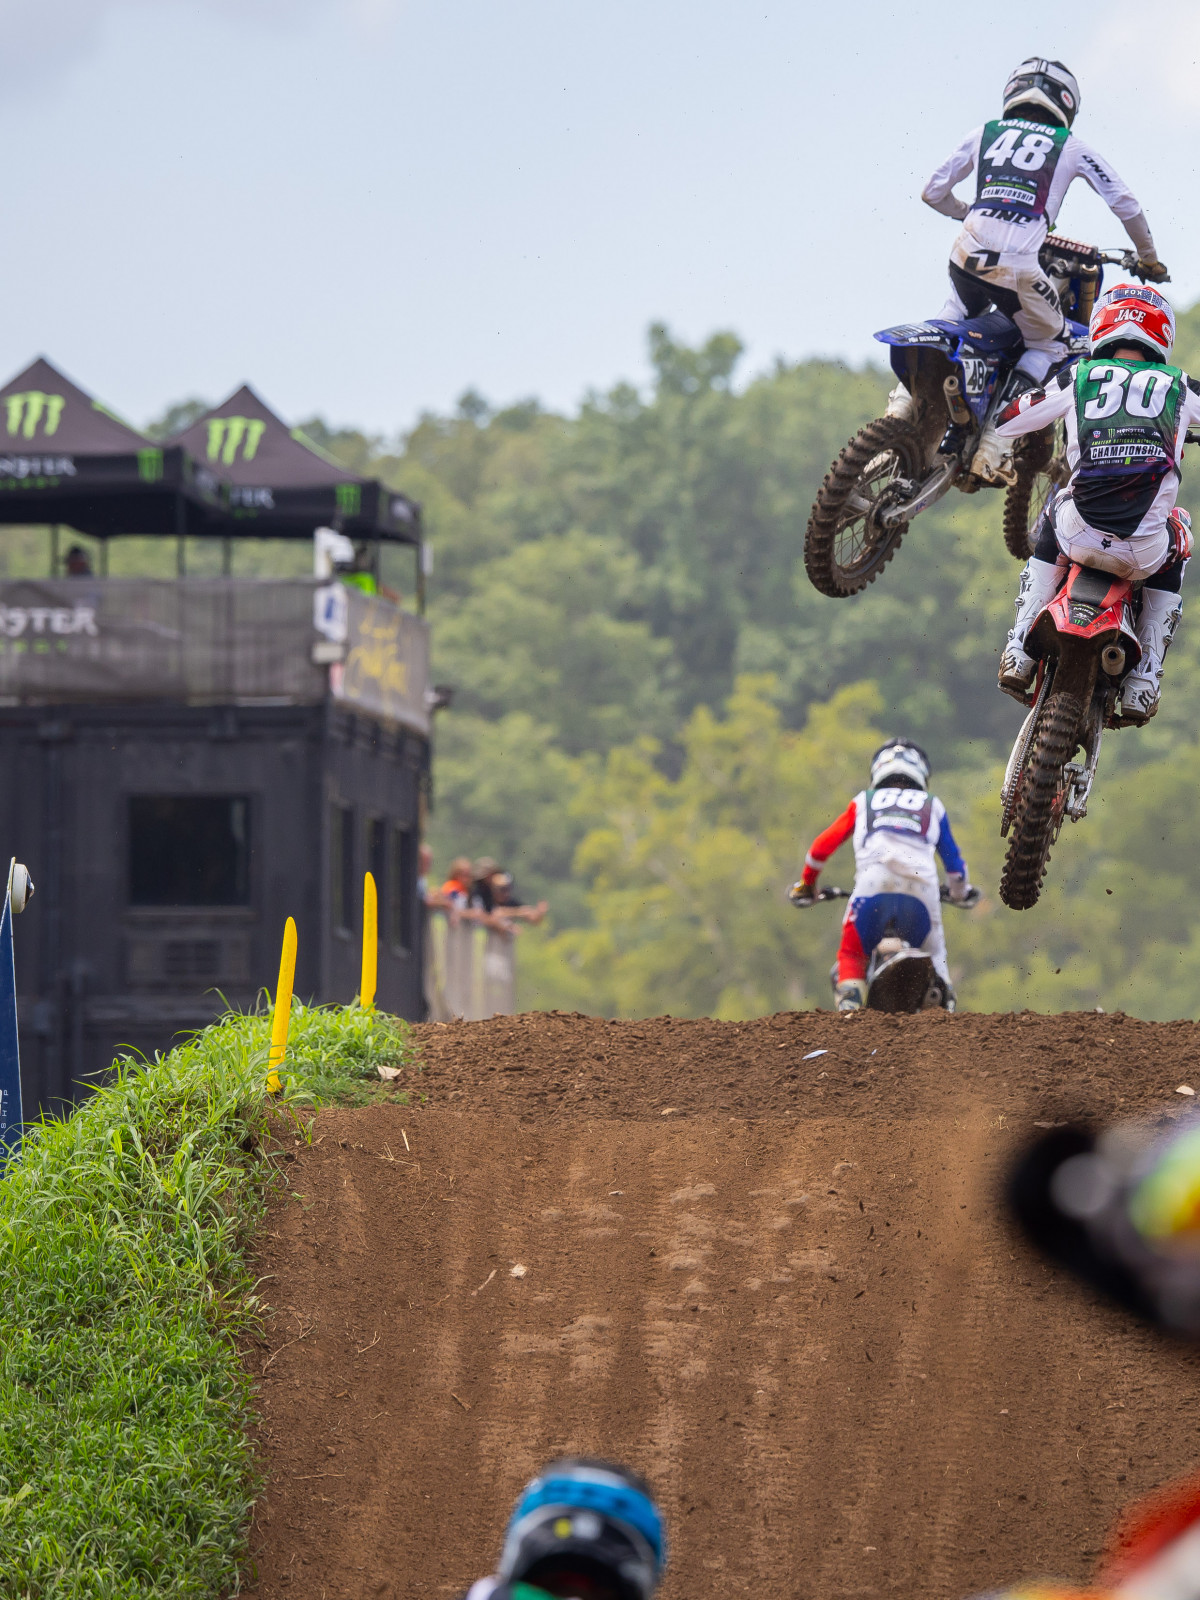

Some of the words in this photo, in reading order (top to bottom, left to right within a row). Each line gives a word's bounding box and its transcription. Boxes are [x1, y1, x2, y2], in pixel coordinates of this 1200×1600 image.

[997, 119, 1056, 136] ROMERO
[983, 128, 1054, 171] 48
[1113, 308, 1146, 324] JACE
[967, 360, 985, 391] 48
[1083, 365, 1174, 420] 30
[1091, 445, 1163, 459] CHAMPIONSHIP
[871, 787, 928, 811] 68
